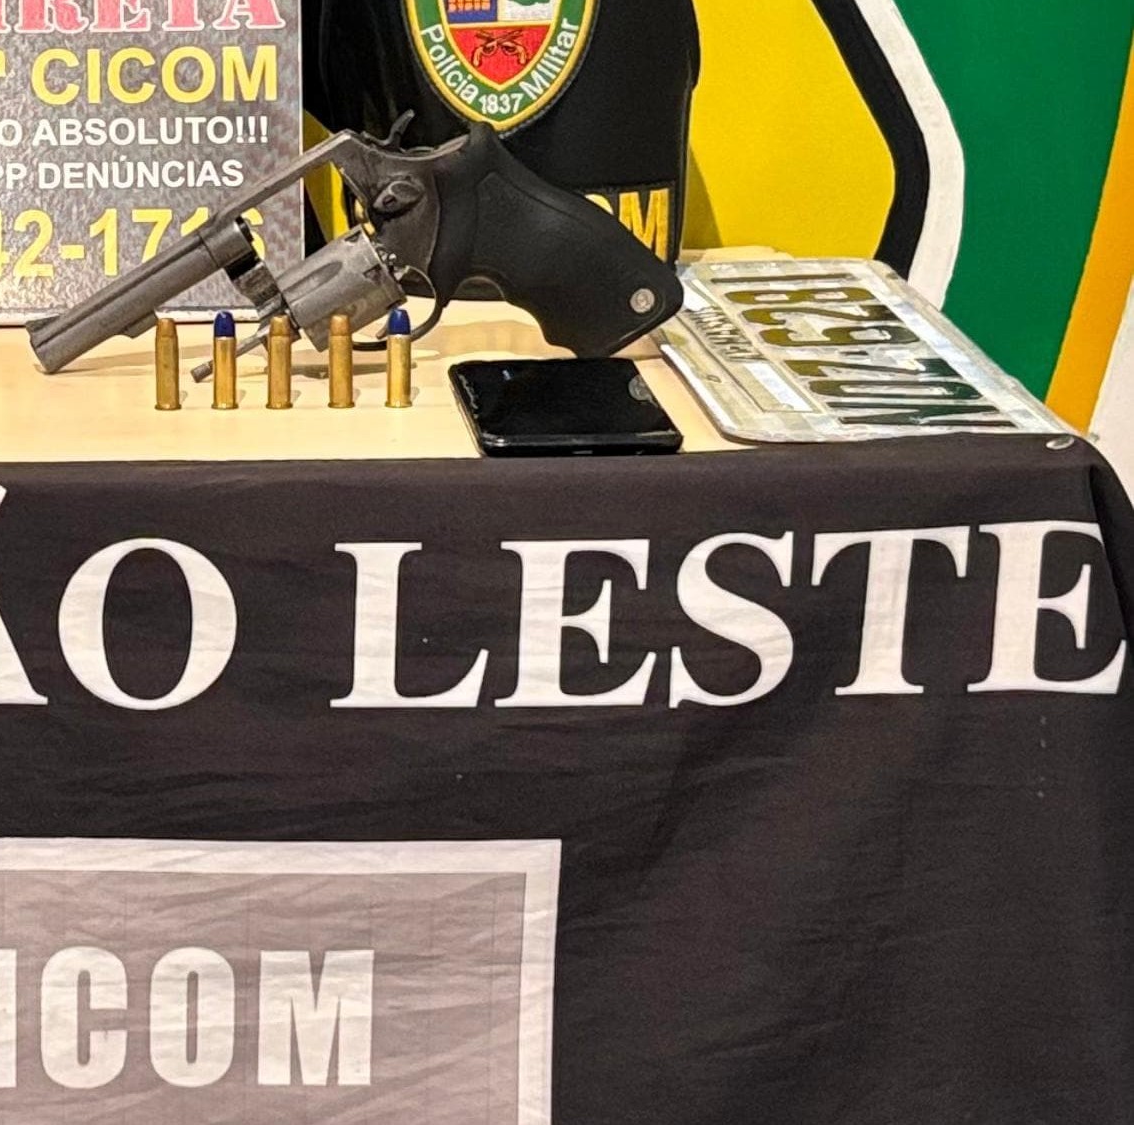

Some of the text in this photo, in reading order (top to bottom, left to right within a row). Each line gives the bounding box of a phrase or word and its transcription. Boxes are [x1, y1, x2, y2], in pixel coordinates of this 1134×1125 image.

[31, 44, 278, 105] CICOM
[478, 92, 524, 115] 1837
[519, 17, 579, 101] Militar
[32, 116, 269, 146] ABSOLUTO!!!
[38, 155, 244, 189] DENÚNCIAS
[330, 520, 1127, 710] LESTE
